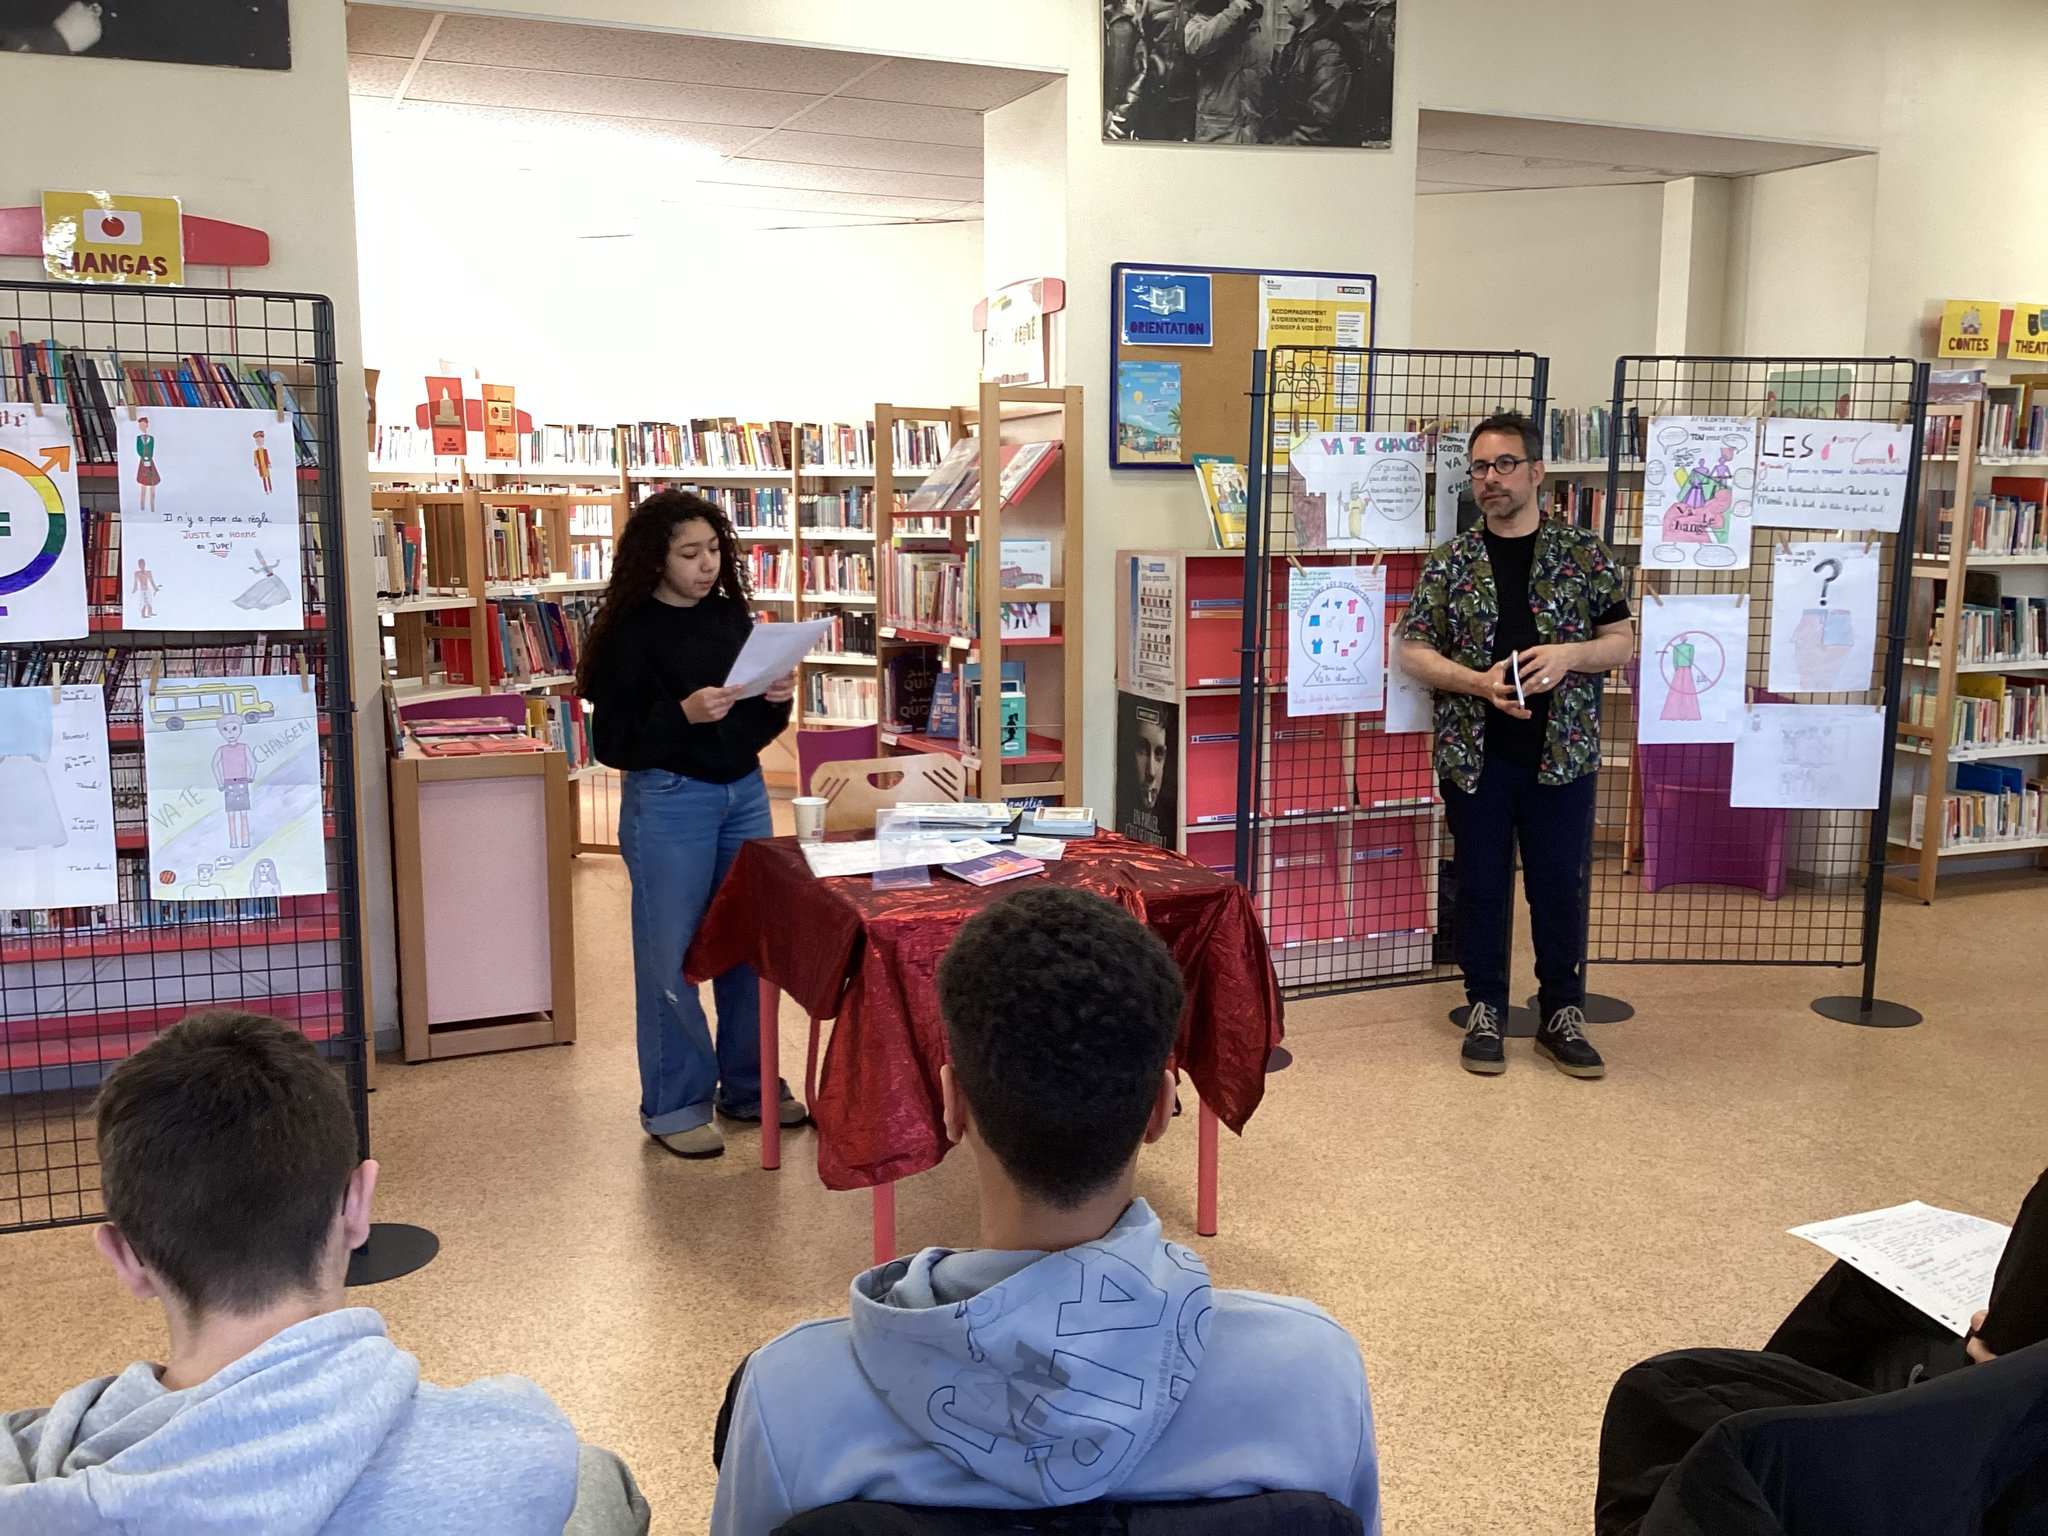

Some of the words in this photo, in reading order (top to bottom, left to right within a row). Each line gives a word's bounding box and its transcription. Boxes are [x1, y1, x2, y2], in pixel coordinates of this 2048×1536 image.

[1271, 308, 1327, 316] ACCOMPAGNEMENT
[1130, 321, 1204, 335] ORIENTATION
[1948, 337, 1989, 351] CONTES
[1321, 437, 1344, 455] VA
[1349, 436, 1366, 455] TE
[1763, 424, 1814, 459] LES
[1445, 457, 1461, 470] VA
[181, 531, 210, 539] JUSTE
[900, 705, 929, 718] QUO
[150, 803, 182, 828] VA
